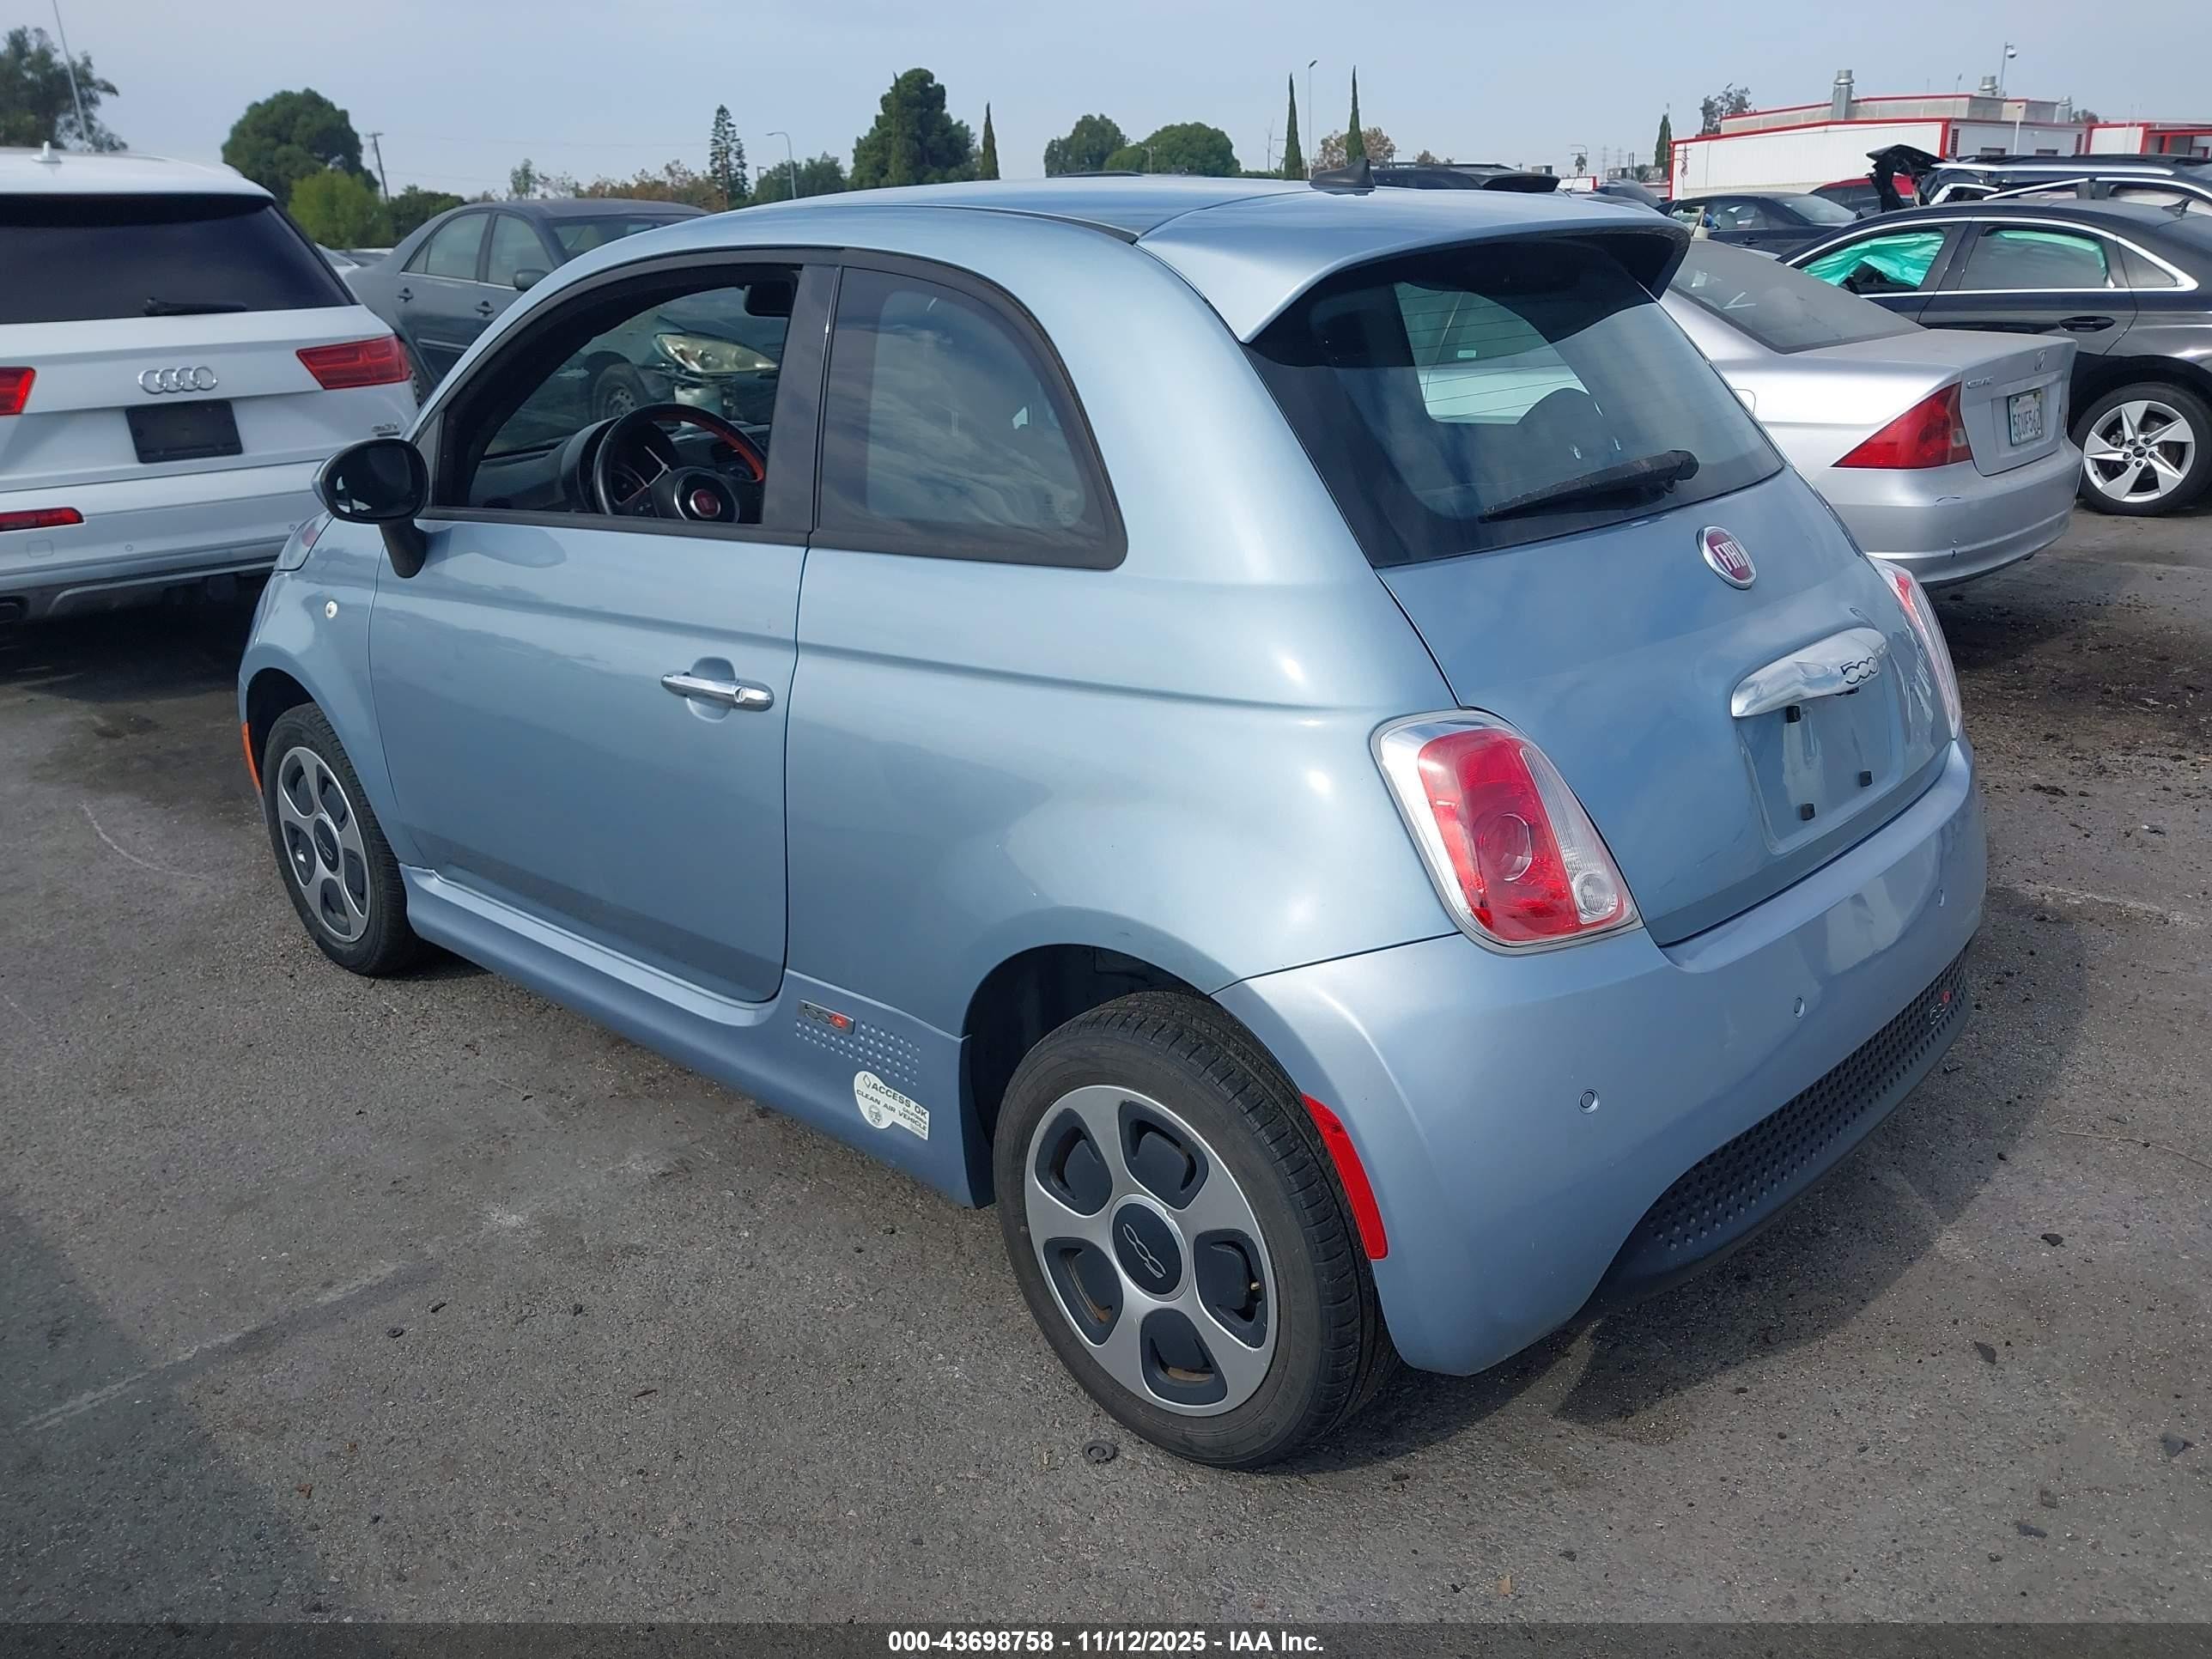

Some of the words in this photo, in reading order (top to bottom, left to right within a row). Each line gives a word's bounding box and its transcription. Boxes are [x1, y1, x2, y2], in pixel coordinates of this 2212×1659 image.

[1712, 540, 1747, 572] FIAT
[1840, 656, 1879, 684] 500
[856, 1089, 881, 1106] CLEAN
[883, 1102, 896, 1114] AIR
[898, 1110, 927, 1132] VEHICLE
[871, 1083, 912, 1109] ACCESS
[914, 1105, 927, 1120] OK
